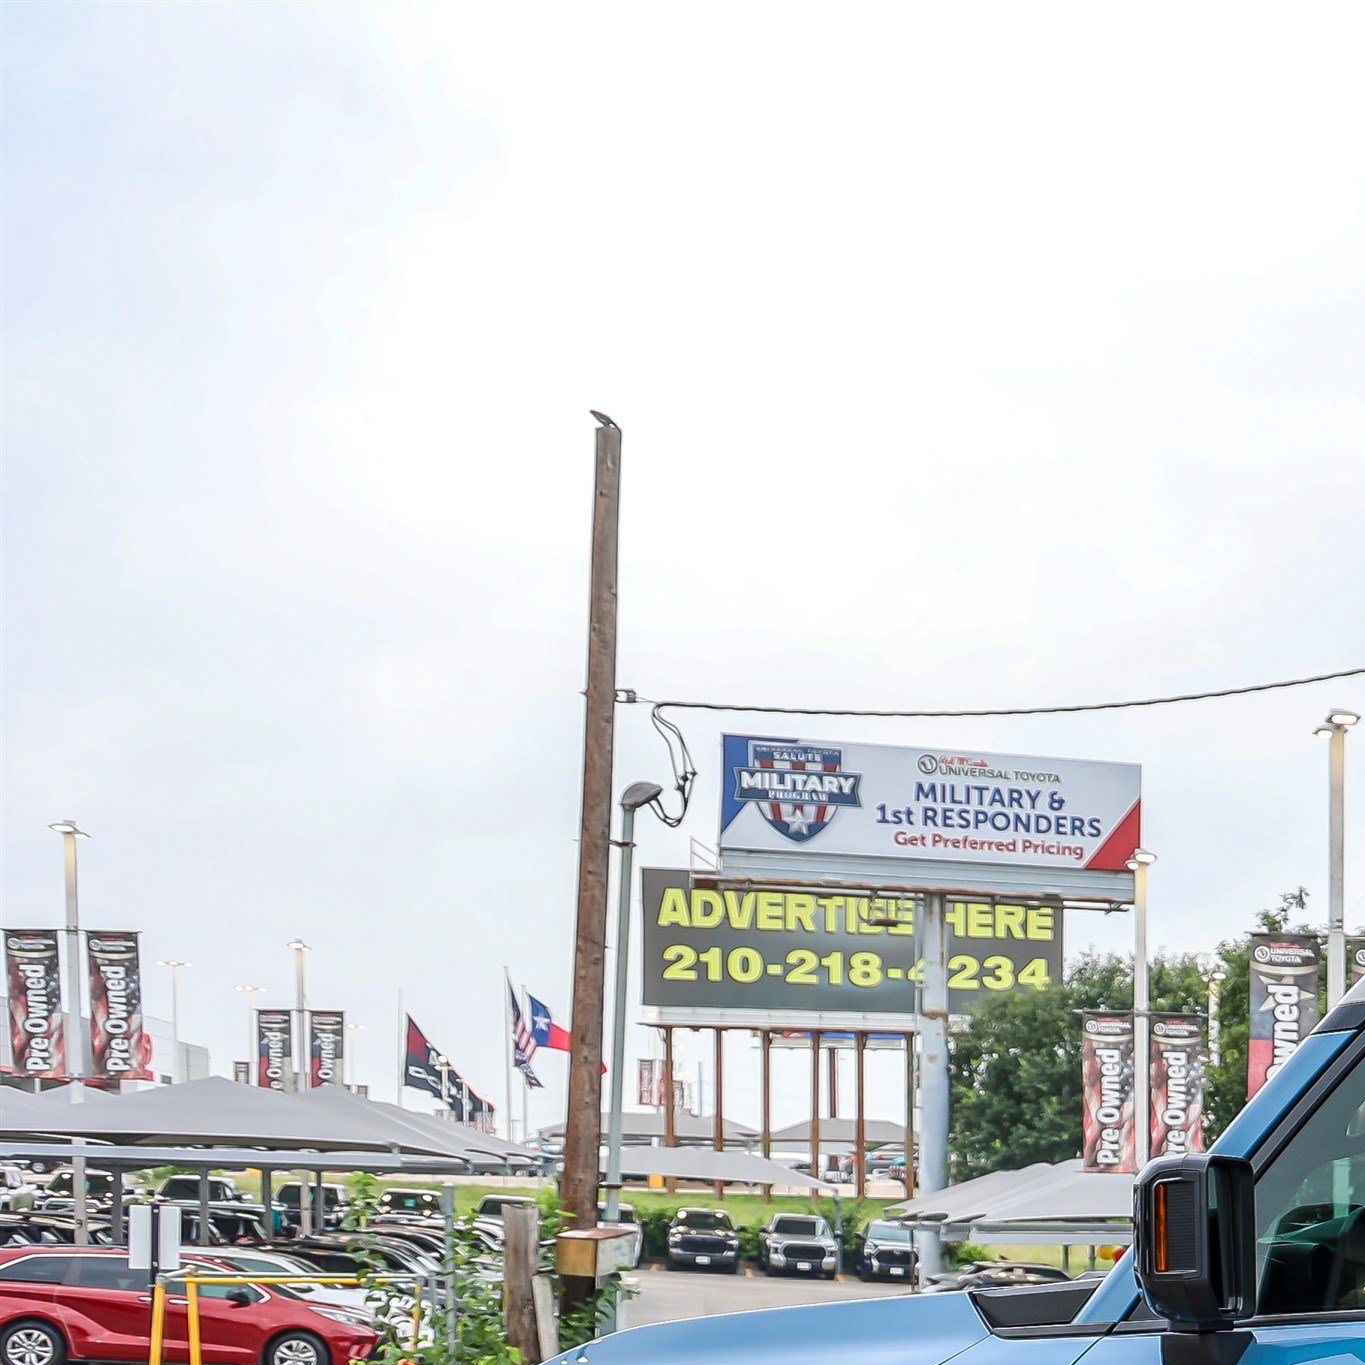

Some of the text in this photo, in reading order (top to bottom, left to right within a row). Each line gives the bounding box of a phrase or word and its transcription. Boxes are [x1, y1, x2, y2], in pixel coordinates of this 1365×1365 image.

[773, 751, 821, 761] SALUTE
[740, 771, 855, 796] MILITARY
[939, 766, 1061, 784] UNIVERSAL TOYOTA
[914, 781, 1065, 812] MILITARY &
[875, 802, 1101, 838] 1st RESPONDERS
[894, 830, 1084, 860] Get Preferred Pricing
[657, 887, 915, 937] ADVERTISE
[18, 964, 49, 1033] Owned
[100, 966, 128, 1034] Owned
[1265, 984, 1300, 1082] wned
[25, 1037, 51, 1071] Pre
[106, 1037, 131, 1071] Pre
[1095, 1049, 1122, 1125] Owned
[1162, 1051, 1188, 1127] Owned
[1096, 1127, 1120, 1165] Pre
